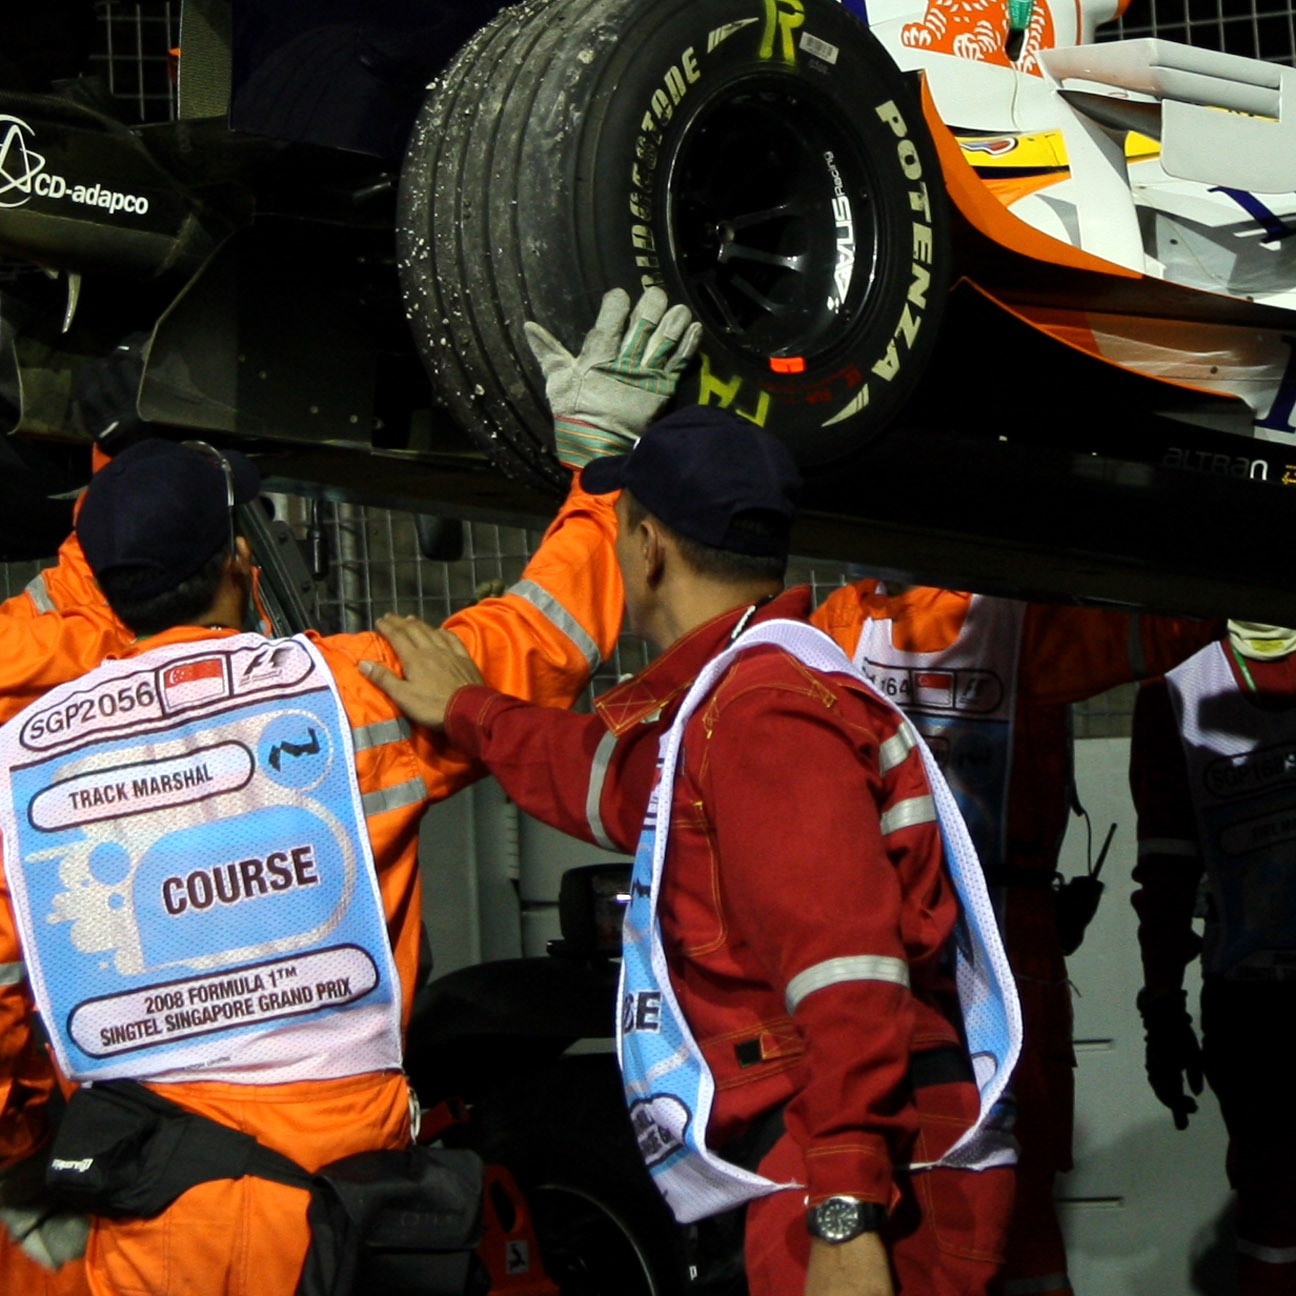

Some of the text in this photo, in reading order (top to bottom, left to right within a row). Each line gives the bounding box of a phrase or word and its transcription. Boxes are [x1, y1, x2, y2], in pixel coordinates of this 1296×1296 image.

[34, 173, 150, 215] CD-adapco
[871, 100, 934, 383] POTENZA
[30, 681, 156, 740] SGP2056
[69, 764, 214, 810] TRACK MARSHAL
[163, 846, 319, 916] COURSE
[100, 977, 353, 1047] SINGTEL SINGAPORE GRAND PRIX
[144, 991, 185, 1014] 2008
[188, 974, 265, 1005] FORMULA
